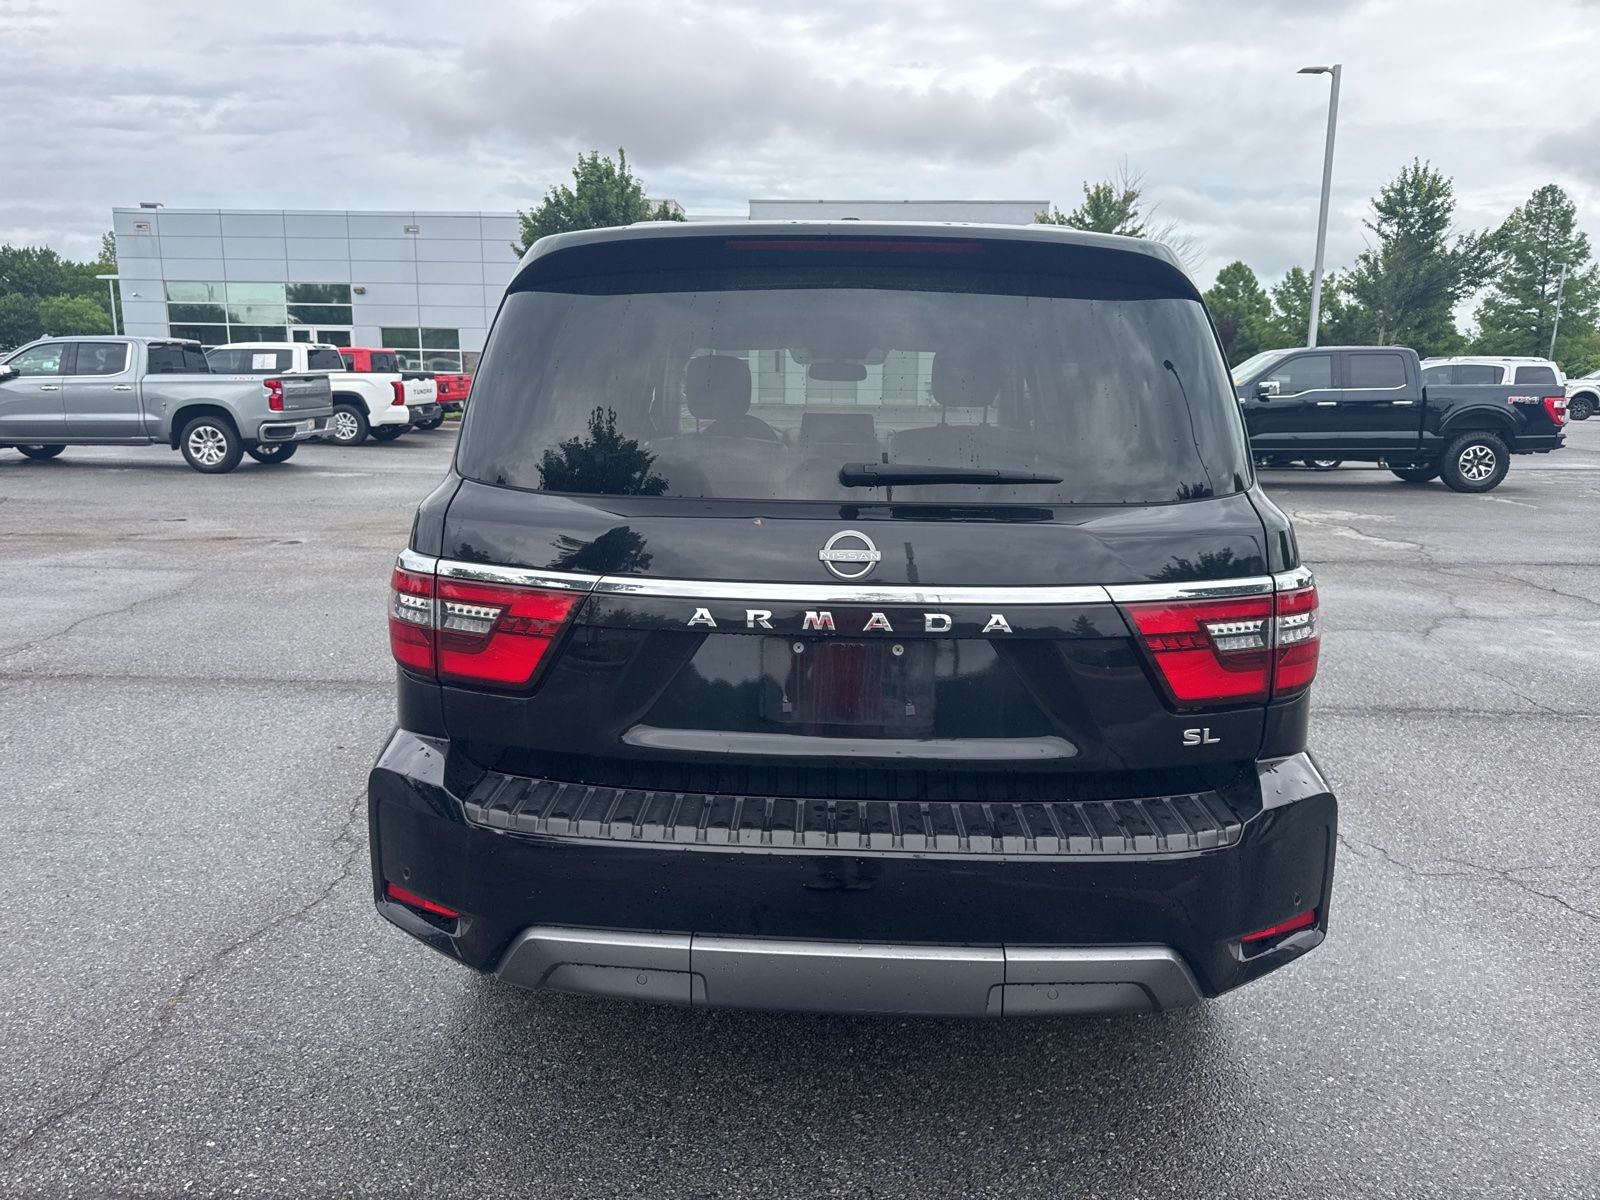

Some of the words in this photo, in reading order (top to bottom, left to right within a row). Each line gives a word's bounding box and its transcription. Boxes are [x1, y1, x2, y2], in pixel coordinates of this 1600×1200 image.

[820, 551, 880, 561] NISSAN
[687, 607, 1013, 634] ARMADA
[1182, 727, 1221, 747] SL
